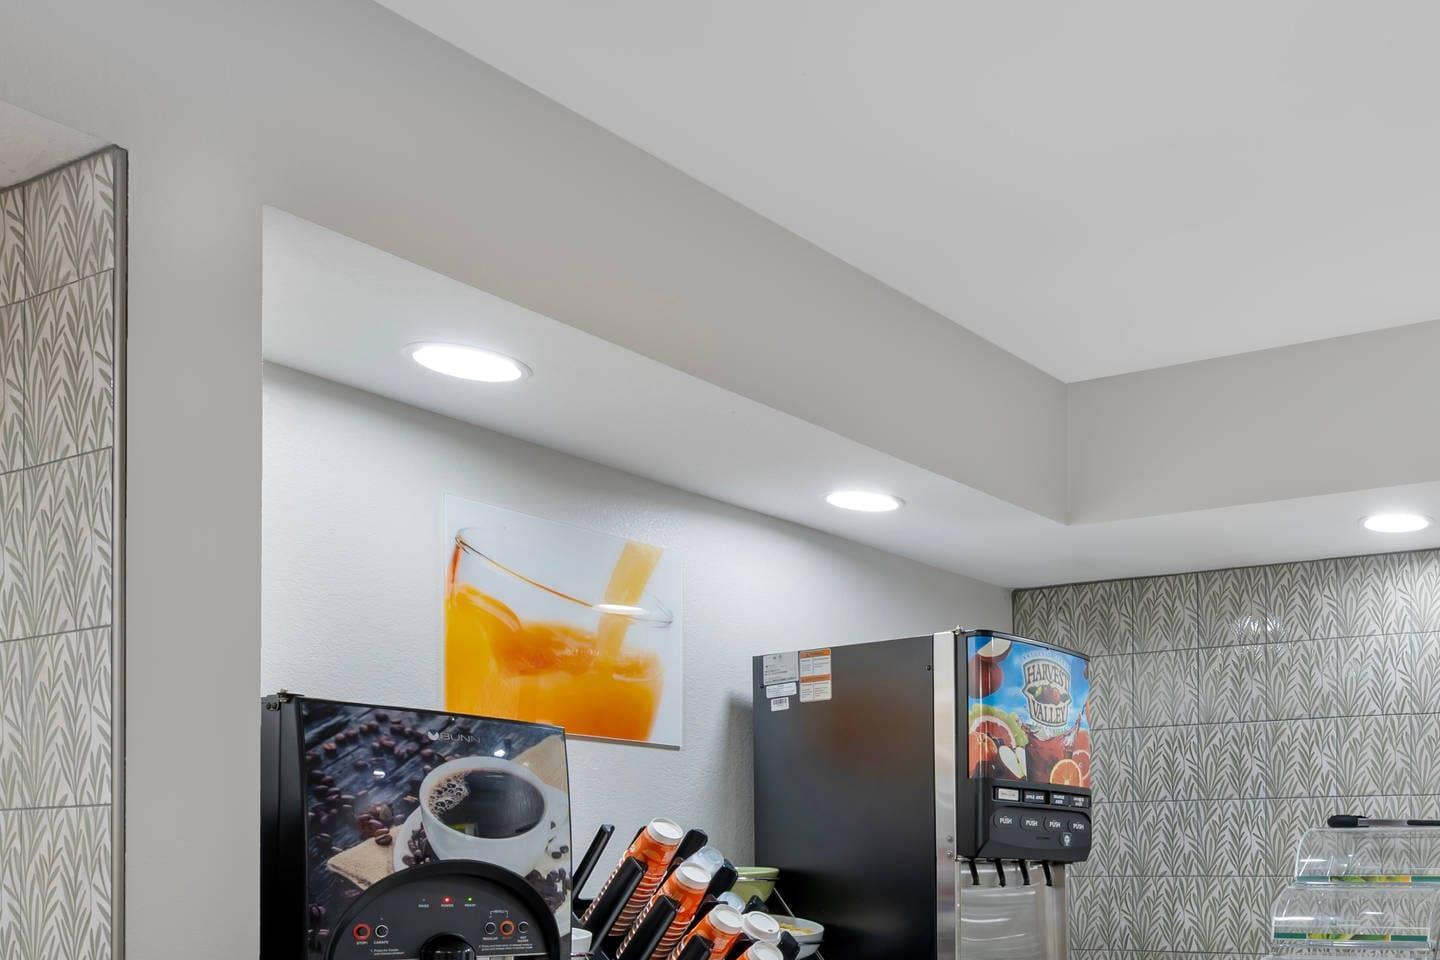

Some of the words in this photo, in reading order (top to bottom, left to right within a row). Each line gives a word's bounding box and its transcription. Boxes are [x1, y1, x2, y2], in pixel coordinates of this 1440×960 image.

[1027, 663, 1069, 690] HARVEST
[1031, 698, 1065, 723] VALLEY
[440, 732, 480, 743] BUNN
